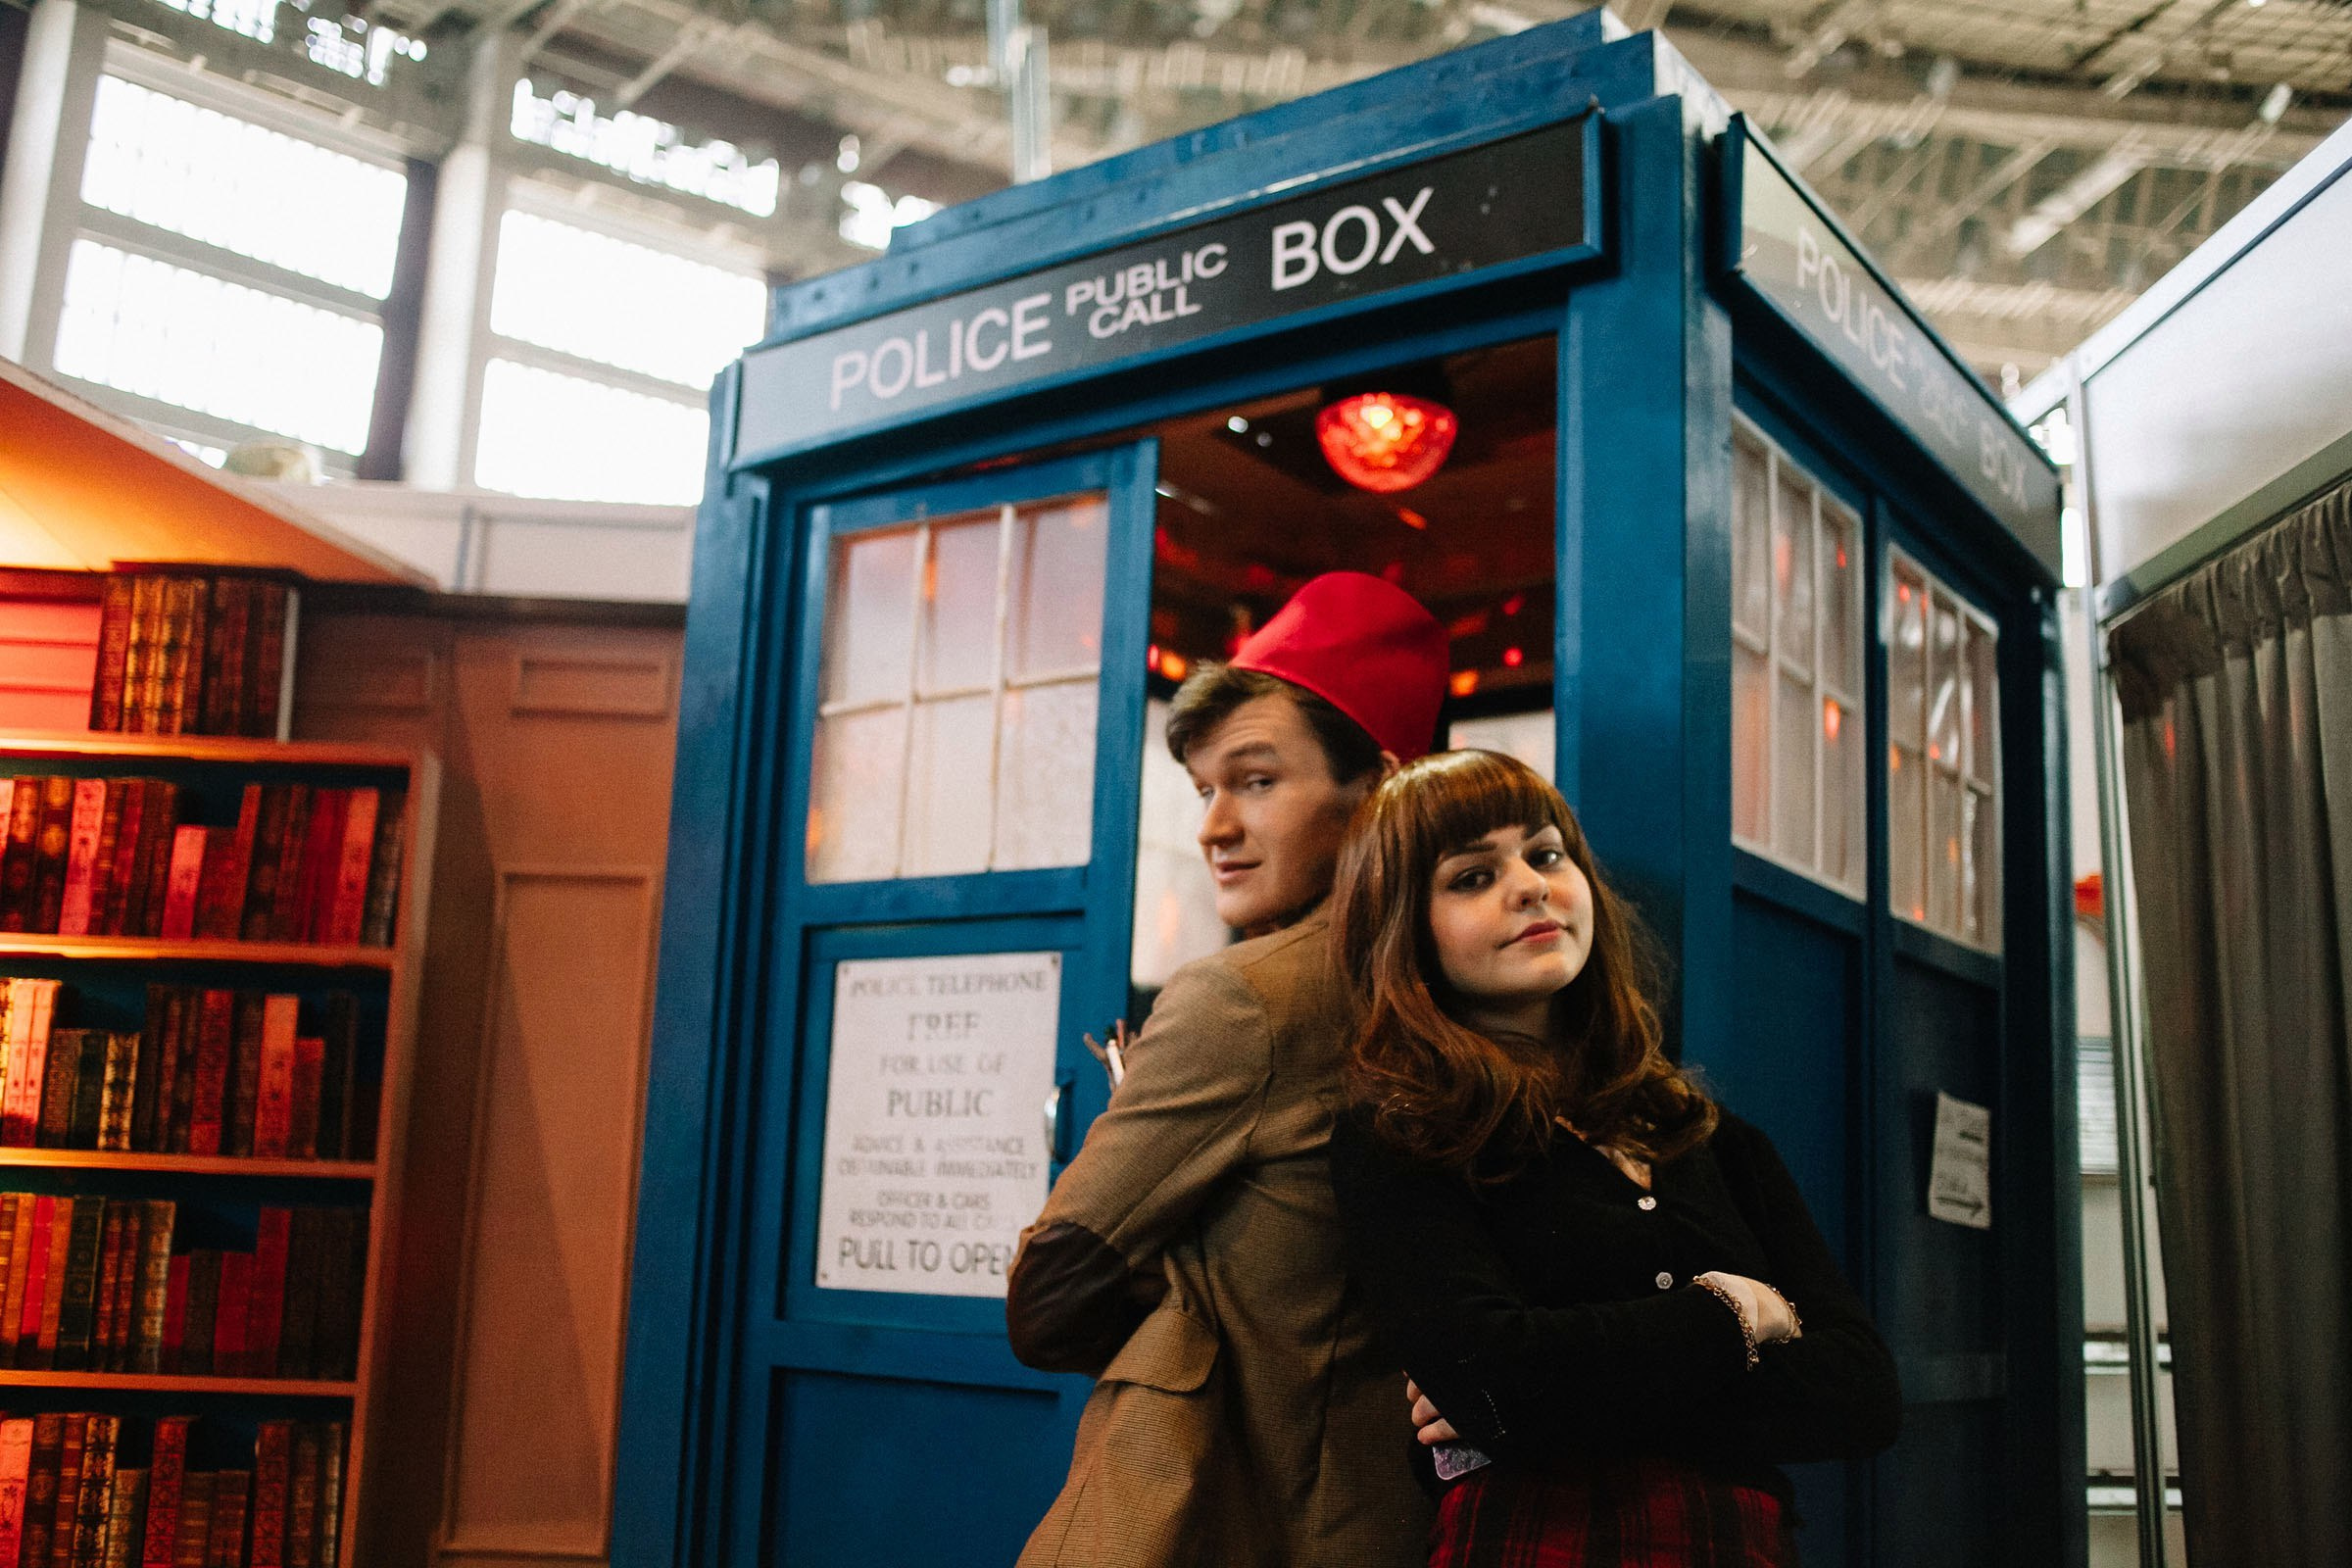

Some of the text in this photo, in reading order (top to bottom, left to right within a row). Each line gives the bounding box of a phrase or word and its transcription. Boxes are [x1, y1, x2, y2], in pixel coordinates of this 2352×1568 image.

[829, 187, 1436, 411] POLICE PUBLIC BOX
[1088, 287, 1202, 340] CALL
[1796, 225, 1907, 391] POLICE
[1980, 420, 2029, 511] BOX
[850, 969, 1047, 998] POLICE TELEPHONE
[879, 1053, 1006, 1076] FOR USE OF
[887, 1088, 994, 1118] PUBLIC
[952, 1193, 991, 1209] CARS
[838, 1236, 897, 1271] PULL
[906, 1239, 942, 1273] TO
